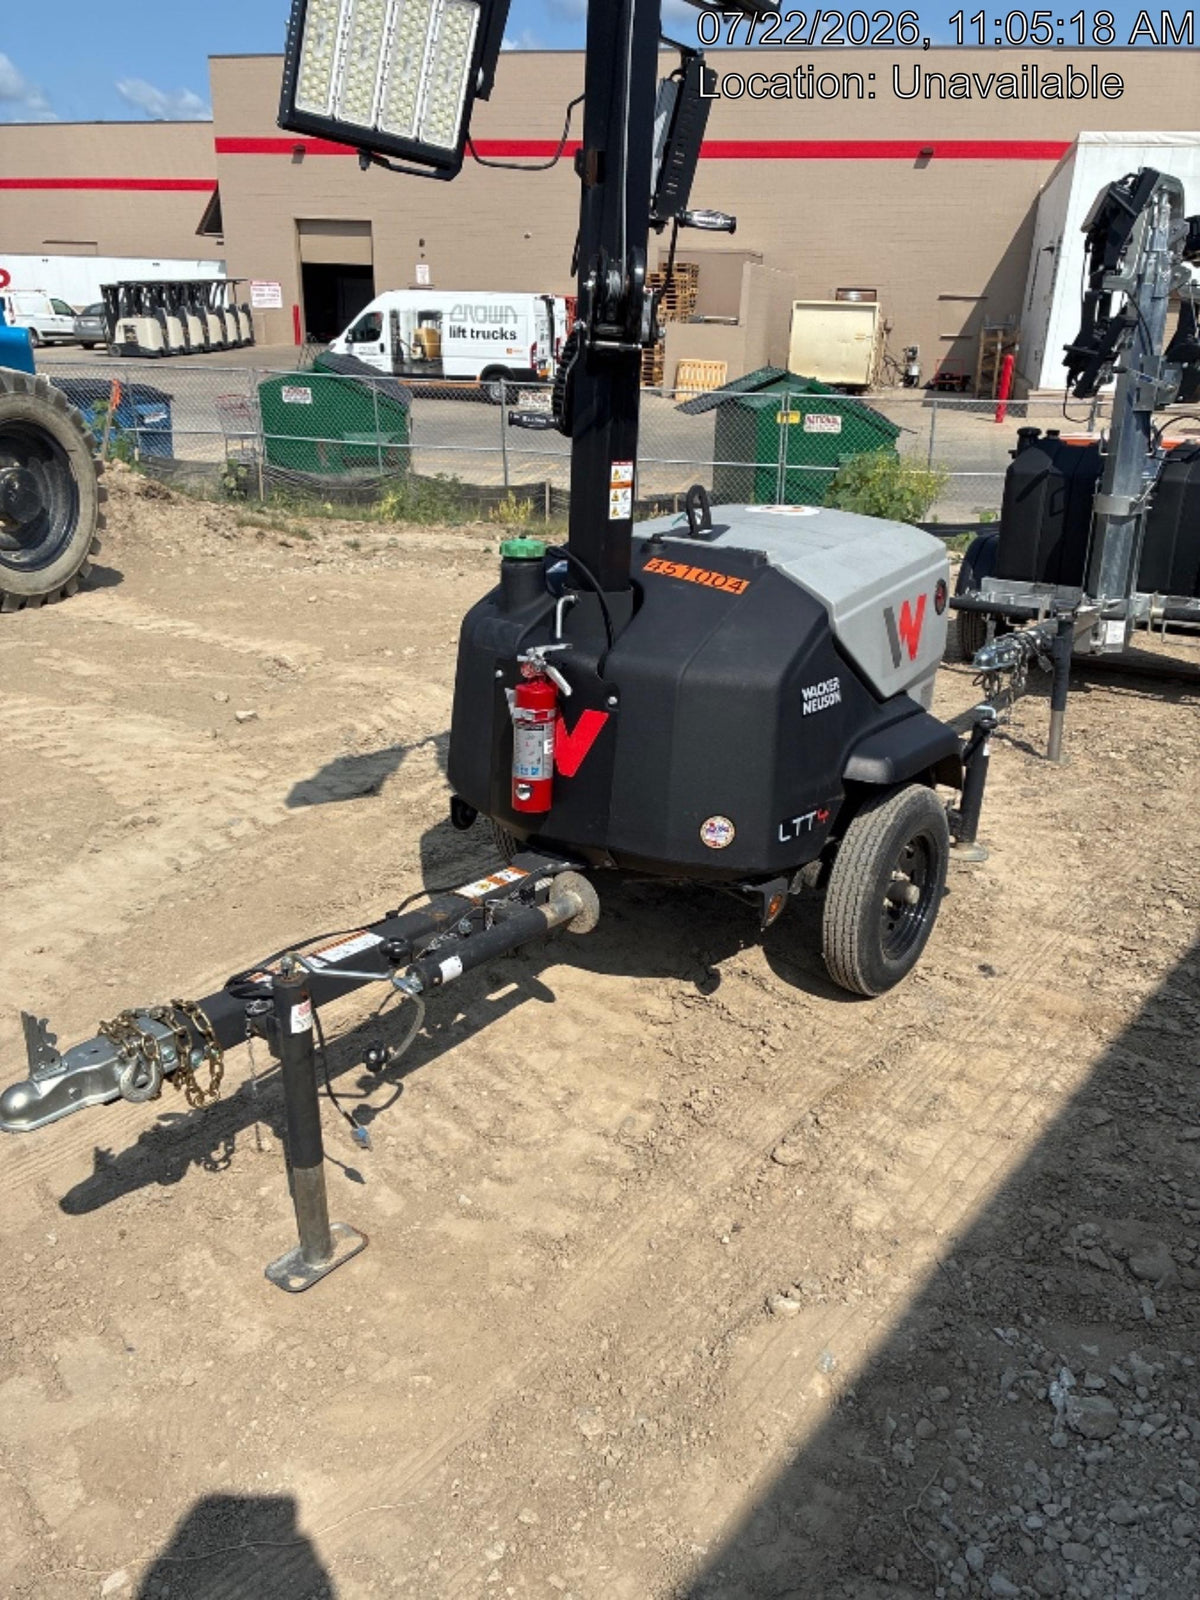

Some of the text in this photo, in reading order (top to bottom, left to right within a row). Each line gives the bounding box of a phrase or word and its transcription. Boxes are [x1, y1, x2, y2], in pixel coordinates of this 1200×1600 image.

[449, 325, 517, 340] lift trucks
[802, 677, 840, 700] WACKER
[803, 690, 842, 716] NEUSON
